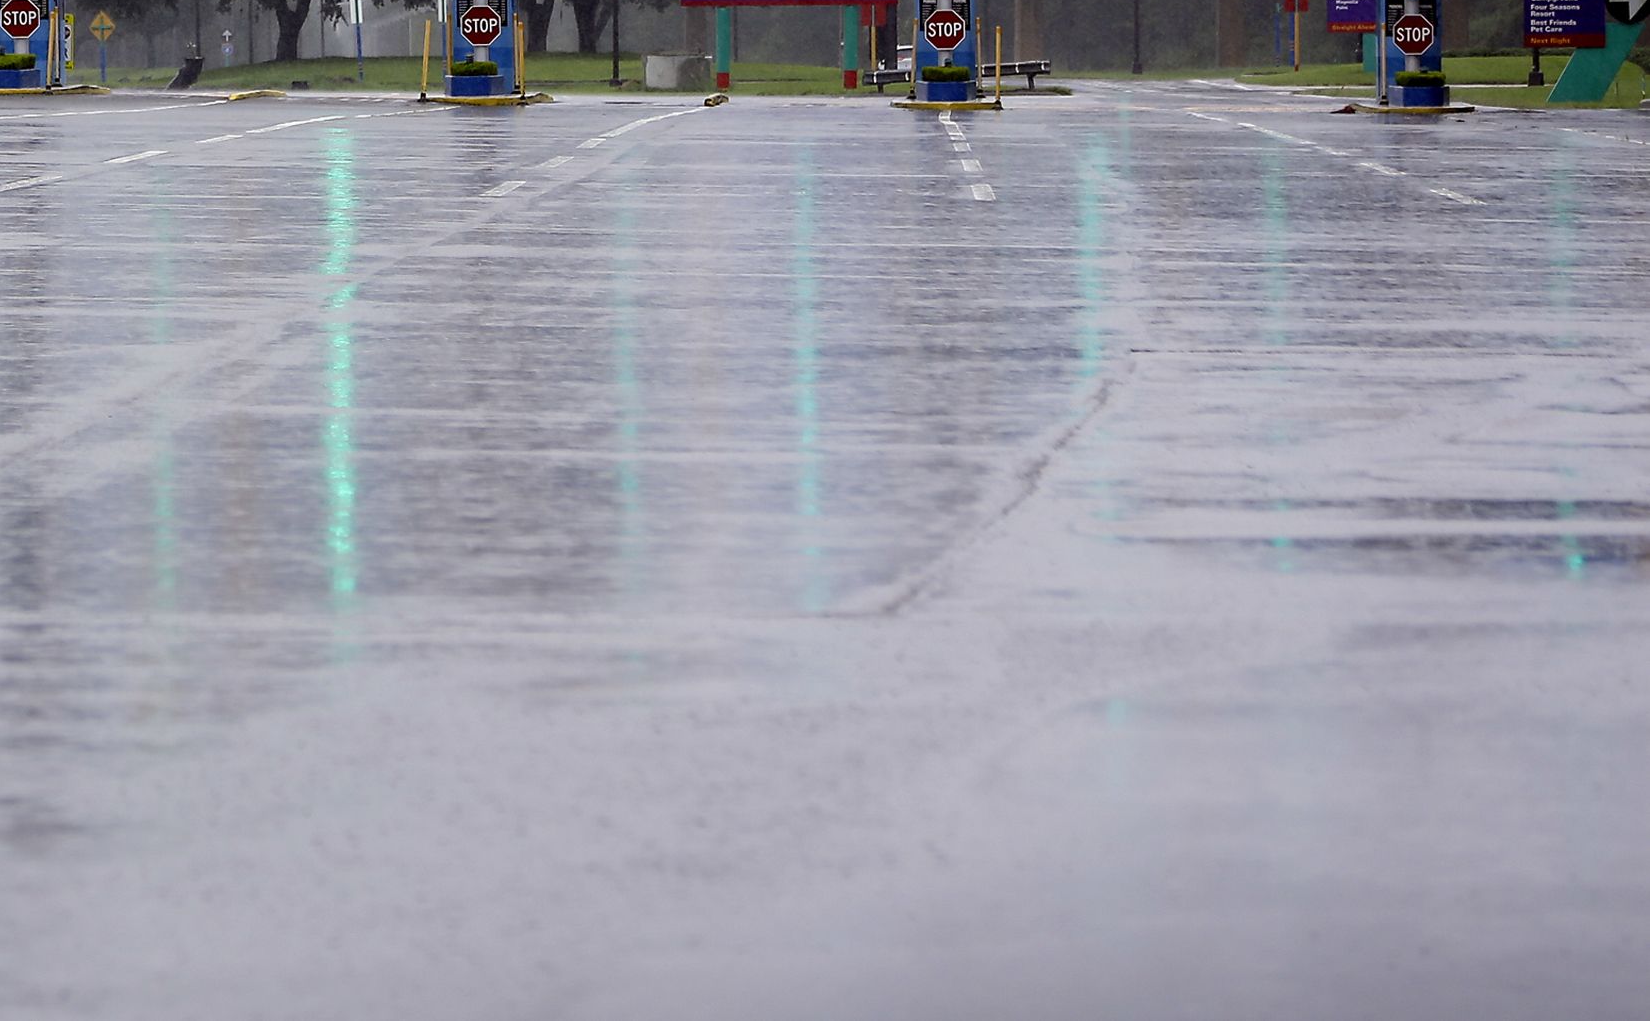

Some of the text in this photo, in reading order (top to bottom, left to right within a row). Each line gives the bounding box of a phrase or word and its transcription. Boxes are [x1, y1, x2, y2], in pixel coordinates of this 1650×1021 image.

[3, 10, 37, 26] STOP
[463, 18, 498, 33] STOP
[928, 22, 962, 38] STOP
[1396, 27, 1431, 42] STOP
[1550, 37, 1570, 45] Right
